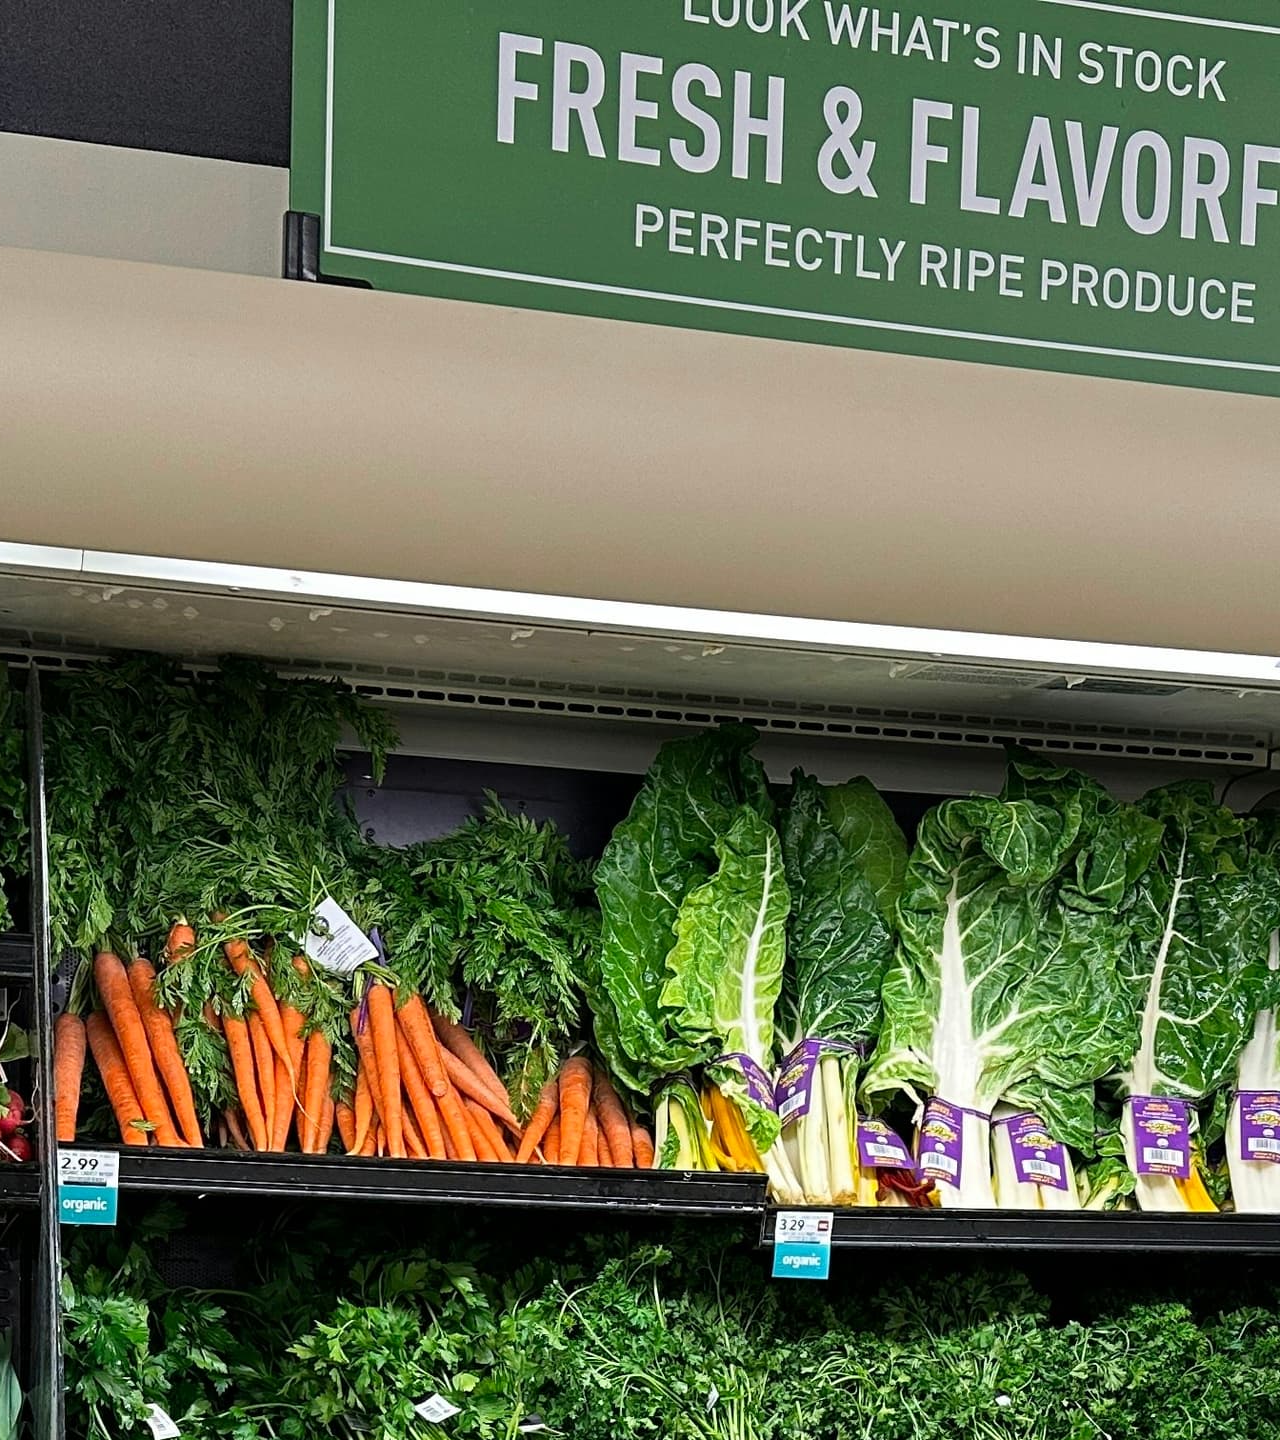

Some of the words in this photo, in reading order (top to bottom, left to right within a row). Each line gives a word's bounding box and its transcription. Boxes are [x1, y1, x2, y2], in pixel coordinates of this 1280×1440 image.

[685, 0, 809, 41] LOOK
[824, 0, 1000, 68] WHAT'S
[1018, 32, 1061, 79] IN
[1078, 43, 1226, 101] STOCK
[497, 32, 784, 184] FRESH
[818, 86, 878, 198] &
[636, 204, 905, 281] PERFECTLY
[921, 244, 1024, 297] RIPE
[1041, 260, 1255, 323] PRODUCE
[61, 1157, 99, 1171] 2.99
[62, 1196, 108, 1213] organic
[782, 1254, 820, 1269] organic
